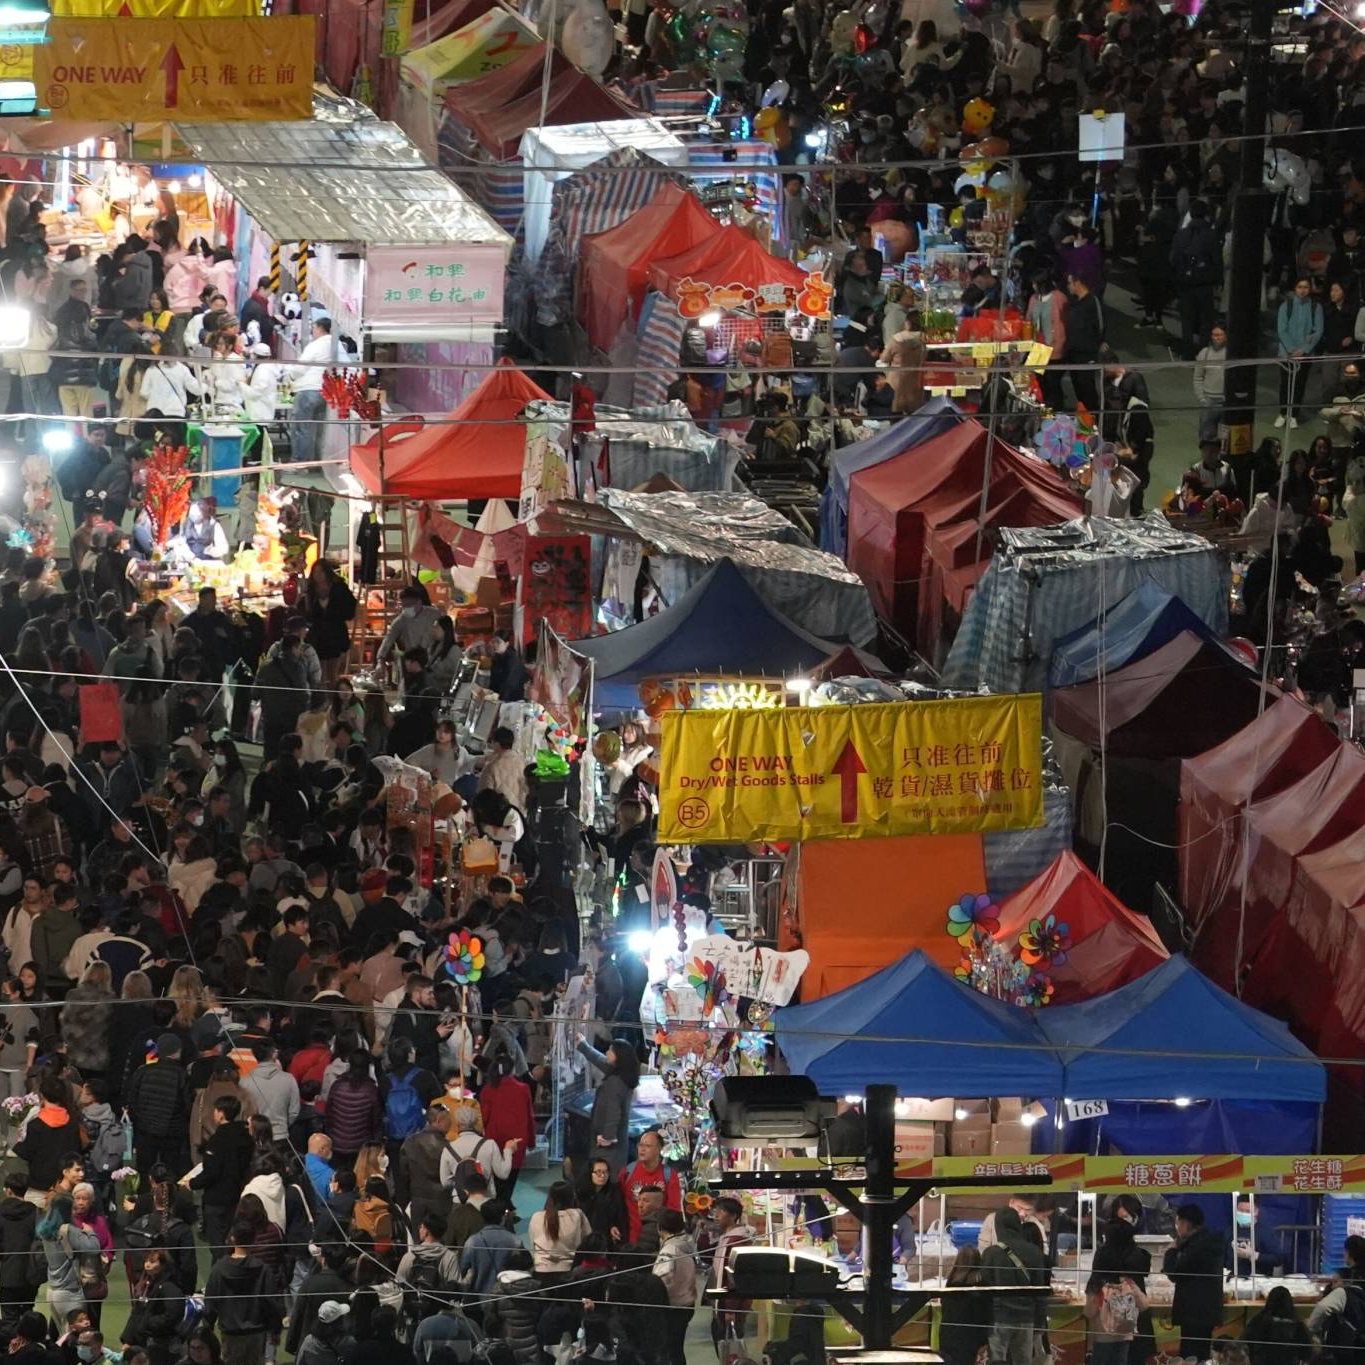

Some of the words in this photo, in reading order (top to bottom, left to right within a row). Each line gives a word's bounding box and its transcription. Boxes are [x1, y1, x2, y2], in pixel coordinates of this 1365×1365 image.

[54, 66, 96, 84] ONE
[102, 66, 147, 84] WAY
[190, 64, 296, 86] 只准往前
[710, 757, 747, 773] ONE
[752, 755, 793, 771] WAY
[901, 741, 1003, 769] 只准往前
[680, 775, 737, 791] Dry/Wet
[741, 774, 786, 788] Goods
[790, 774, 825, 787] Stalls
[682, 804, 706, 821] B5
[1073, 1100, 1104, 1118] 168
[1292, 1159, 1344, 1175] 花生糖
[1292, 1175, 1344, 1191] 花生酥
